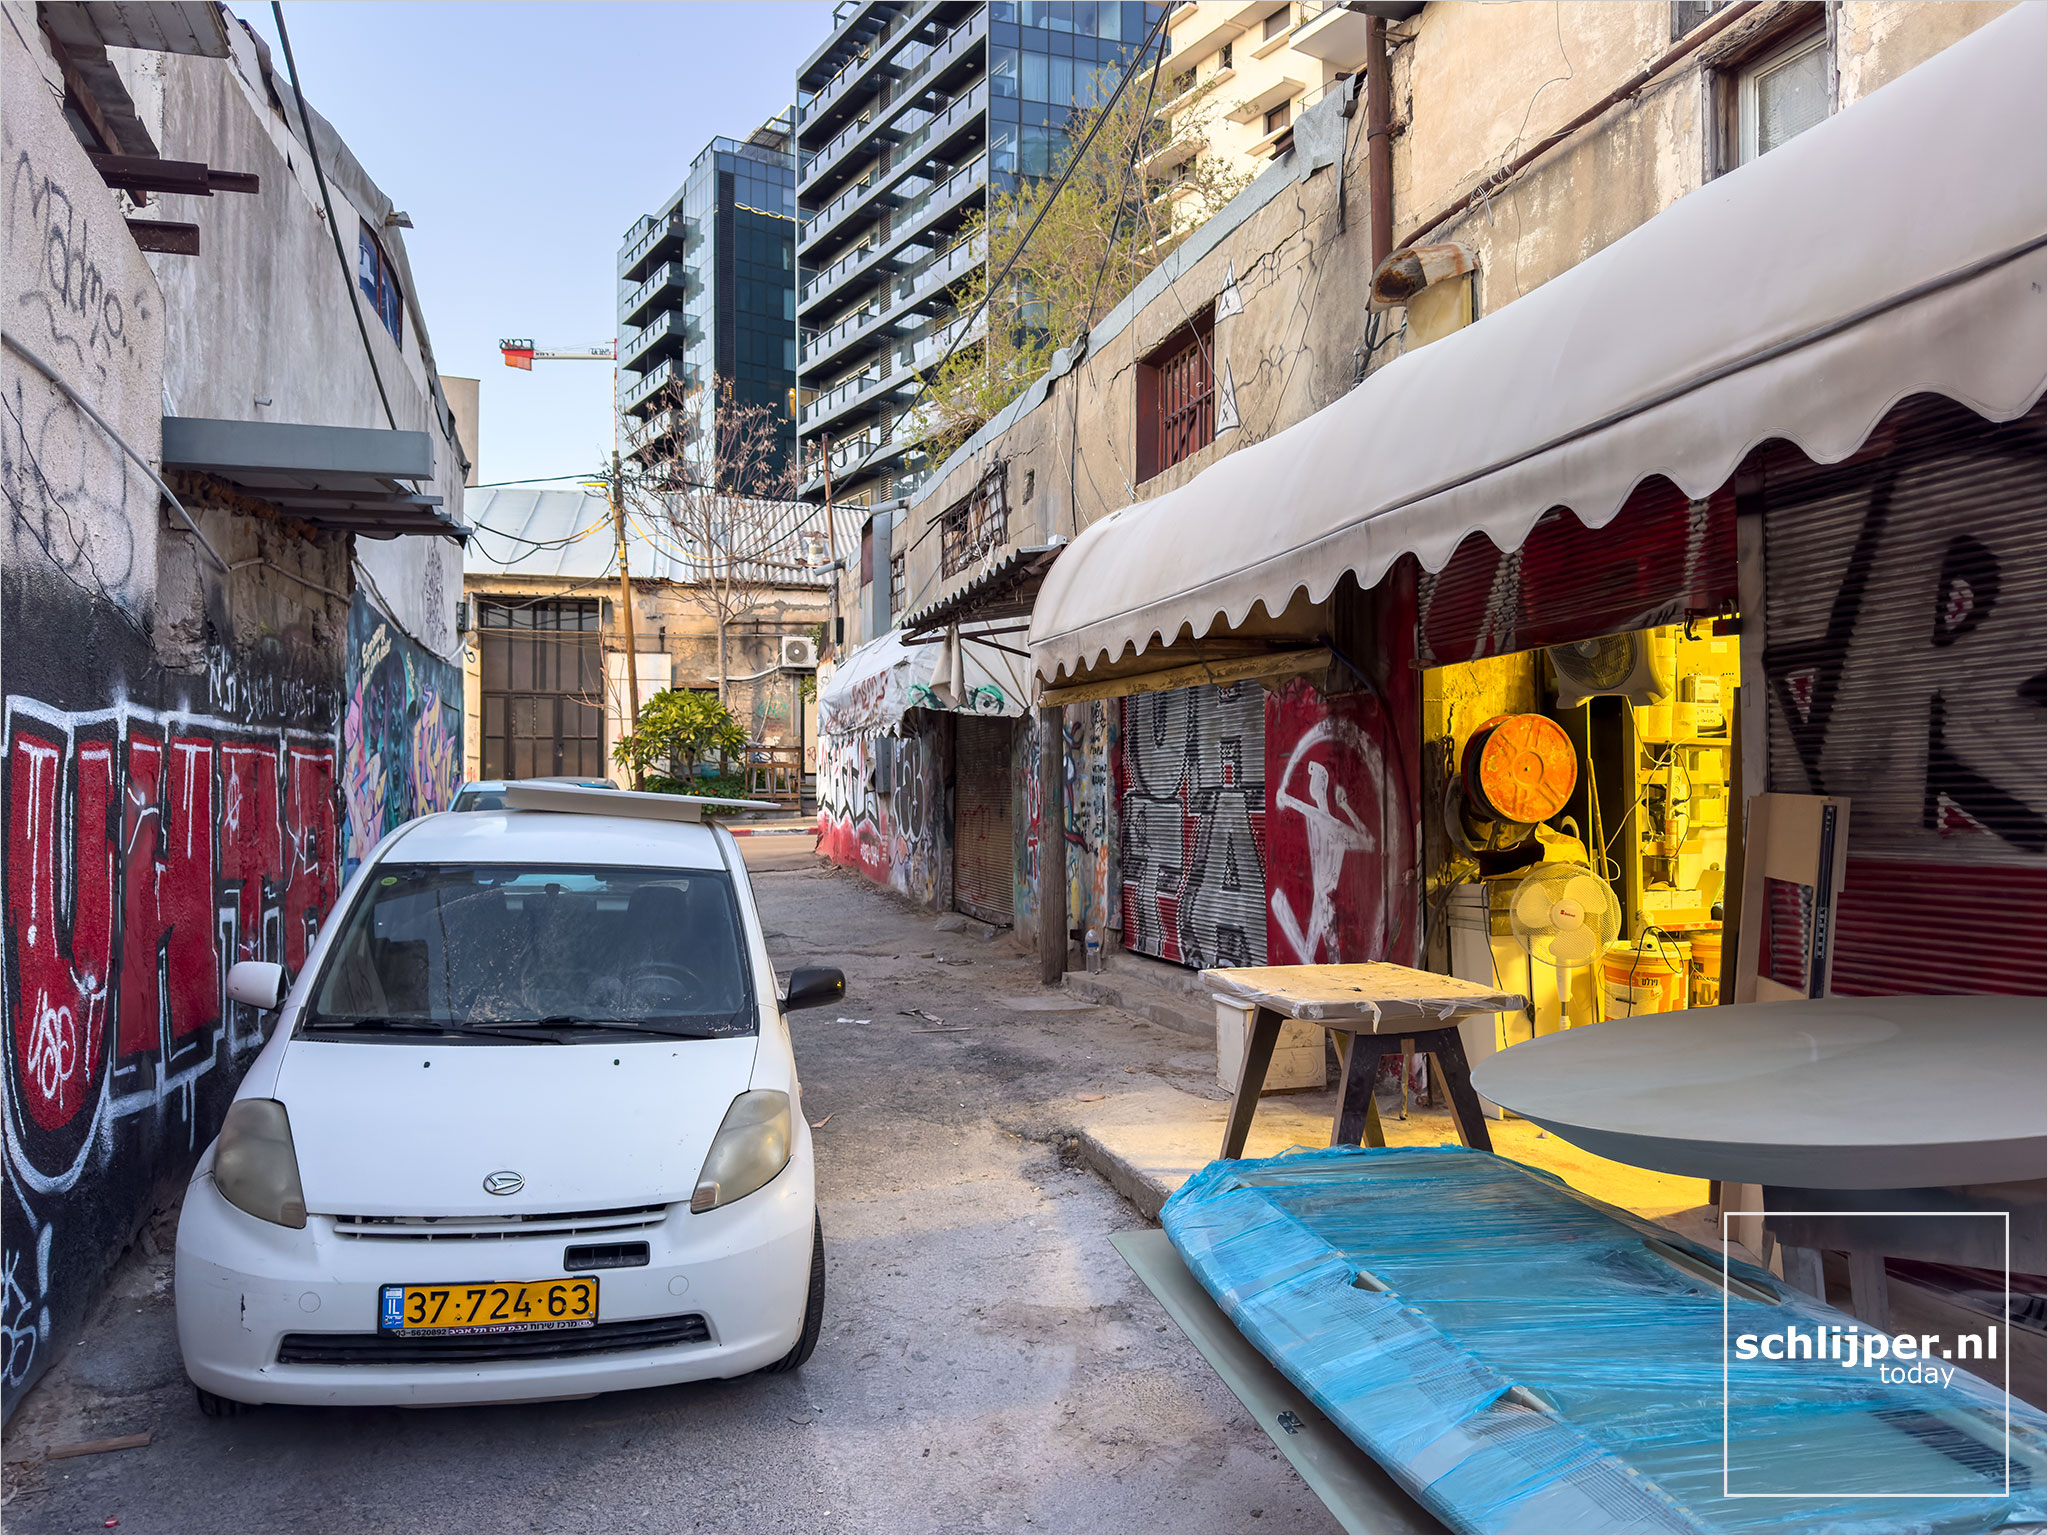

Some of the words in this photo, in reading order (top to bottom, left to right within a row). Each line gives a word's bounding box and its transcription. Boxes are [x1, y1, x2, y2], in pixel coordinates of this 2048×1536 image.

[388, 1299, 400, 1315] IL
[530, 1321, 555, 1330] שירות
[557, 1320, 577, 1328] מרכז
